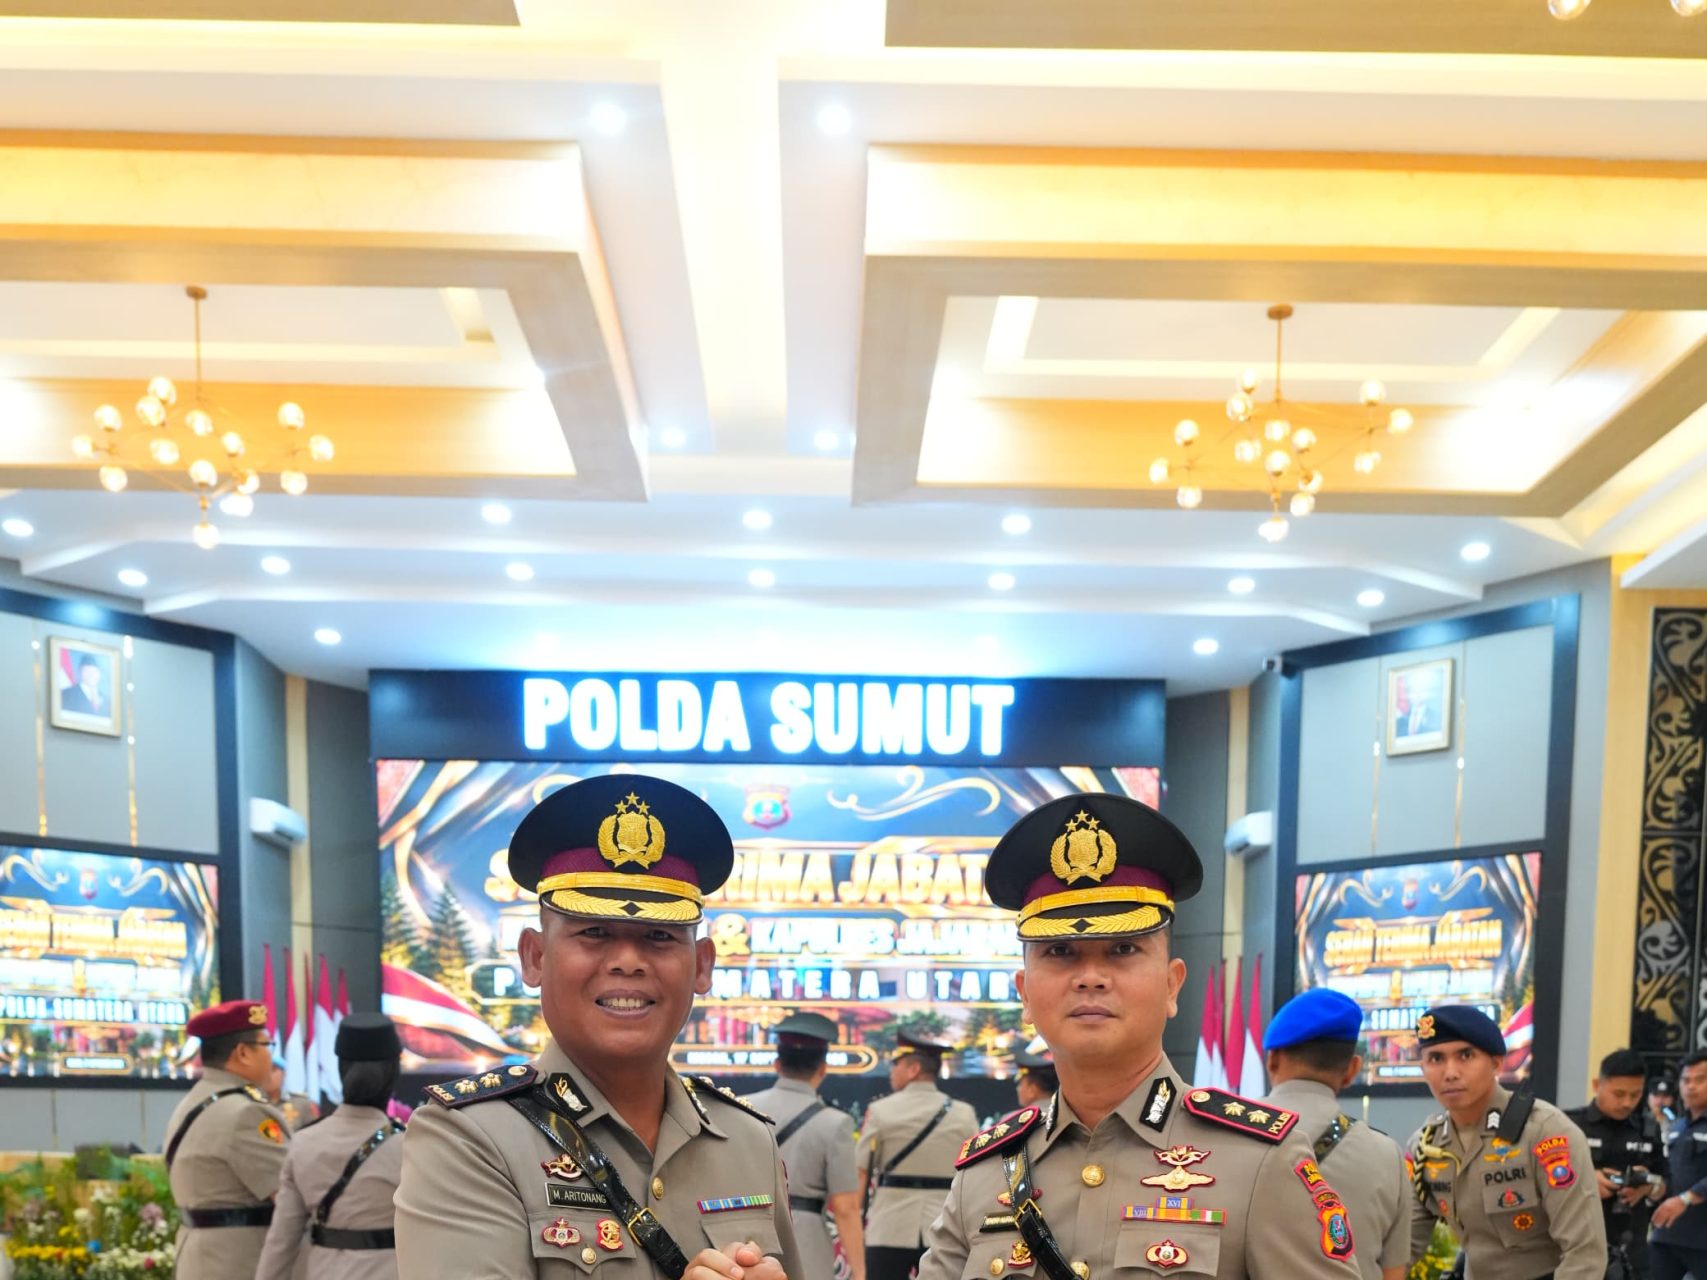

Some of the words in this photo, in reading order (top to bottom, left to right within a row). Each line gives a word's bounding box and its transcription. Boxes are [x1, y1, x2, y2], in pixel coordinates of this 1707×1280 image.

[523, 678, 751, 752] POLDA
[770, 681, 1015, 756] SUMUT
[704, 851, 835, 902] RIMA
[837, 852, 994, 906] JABAT
[710, 969, 881, 1000] MATERA
[906, 970, 1022, 1001] UTAR
[1535, 1137, 1566, 1155] POLDA
[1484, 1167, 1527, 1187] POLRI
[564, 1190, 607, 1204] ARITONANG
